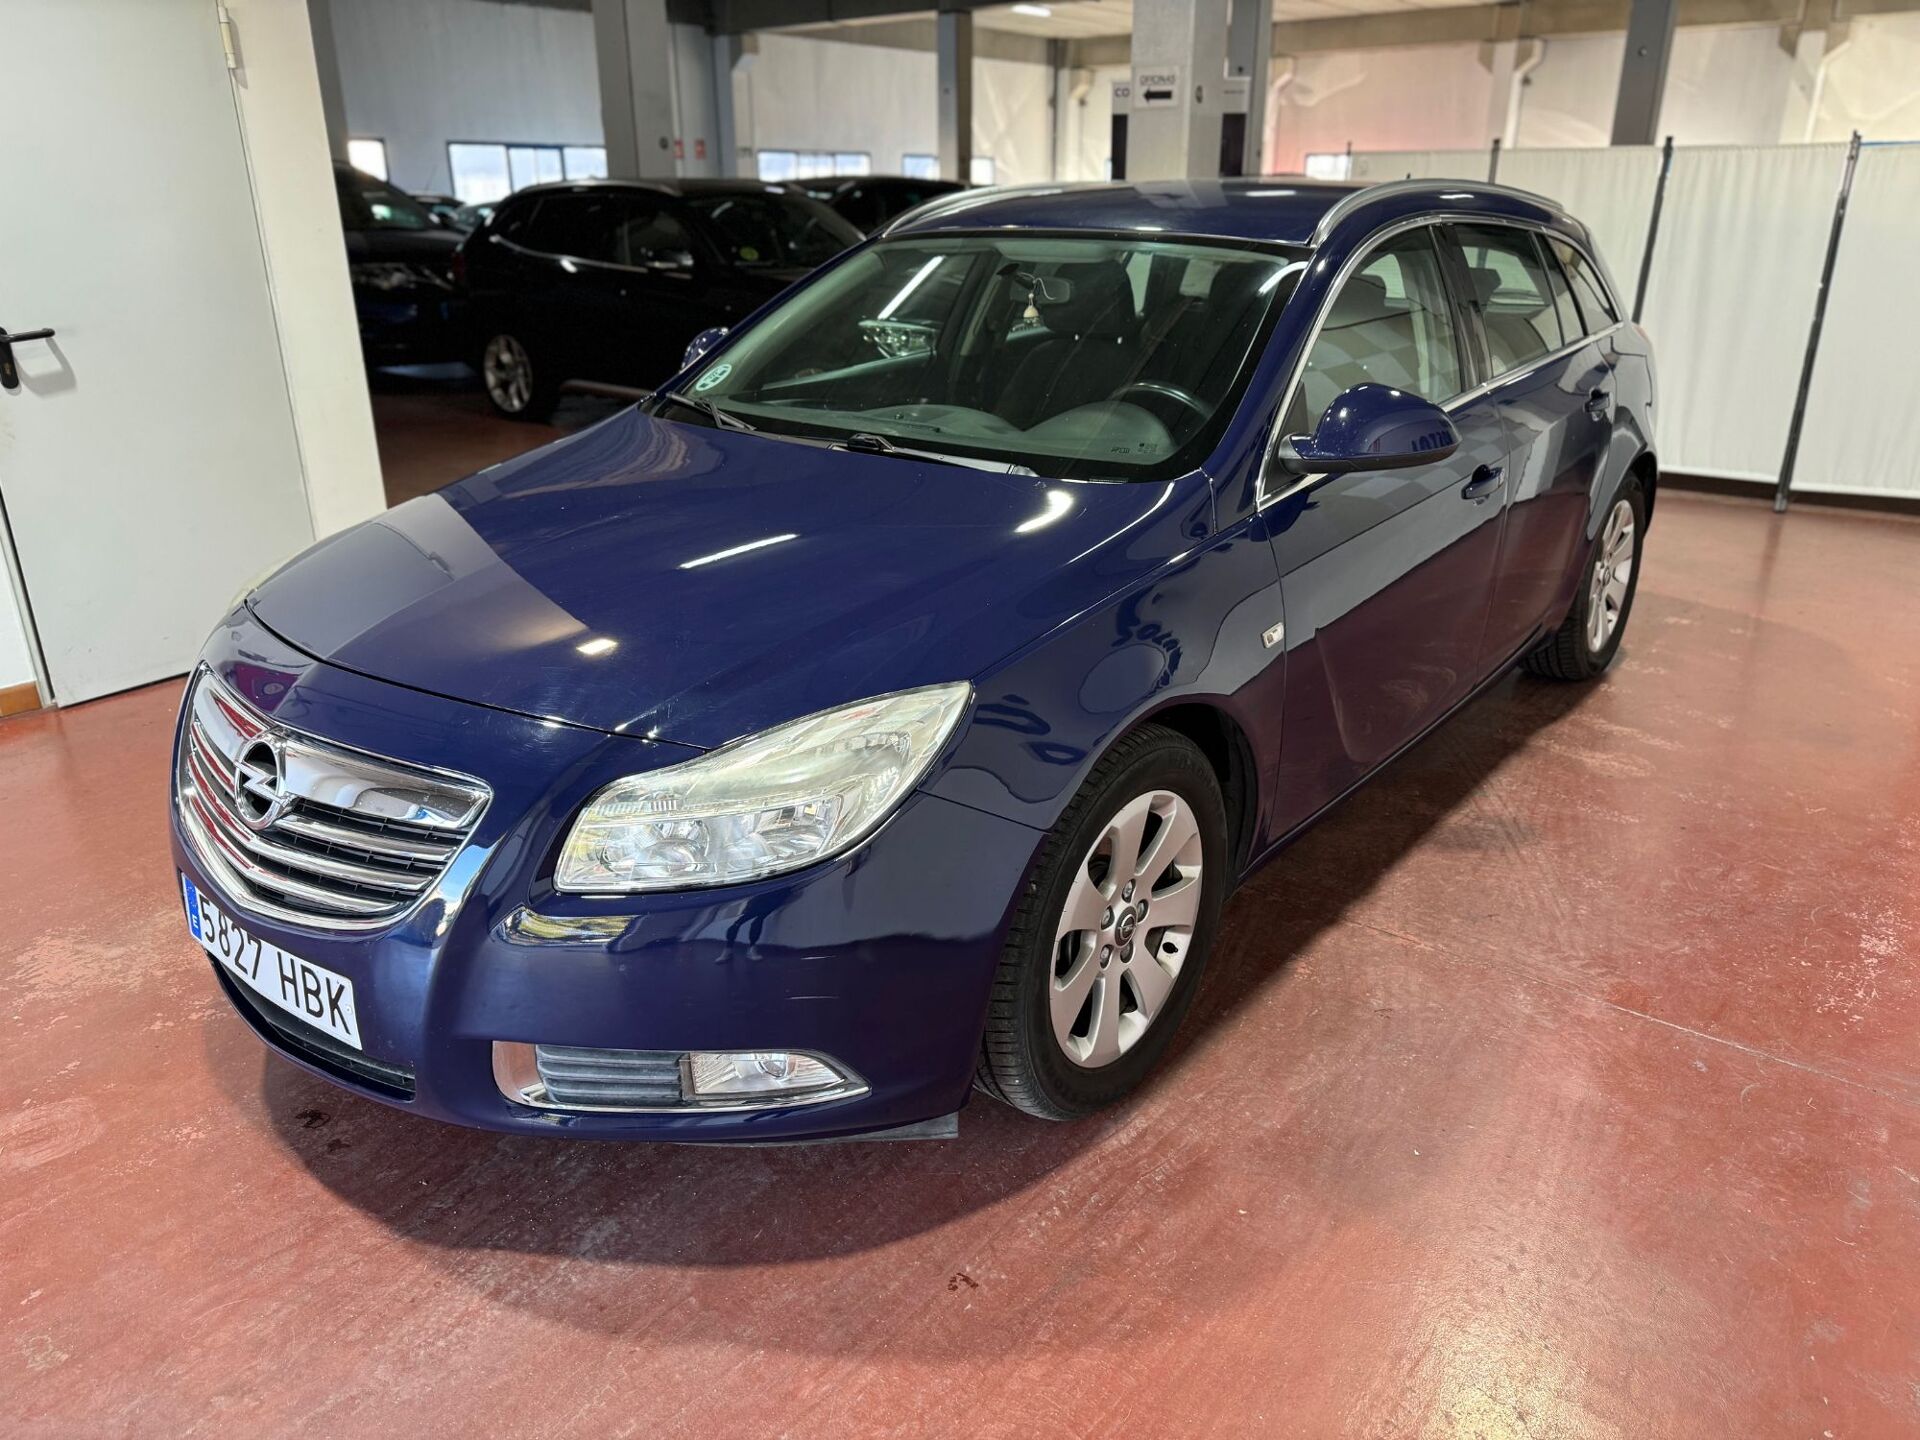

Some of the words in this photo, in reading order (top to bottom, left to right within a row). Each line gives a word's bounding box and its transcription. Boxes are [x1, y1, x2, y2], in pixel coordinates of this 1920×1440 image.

[191, 914, 199, 929] E
[199, 894, 262, 980] 5827
[277, 951, 351, 1035] HBK
